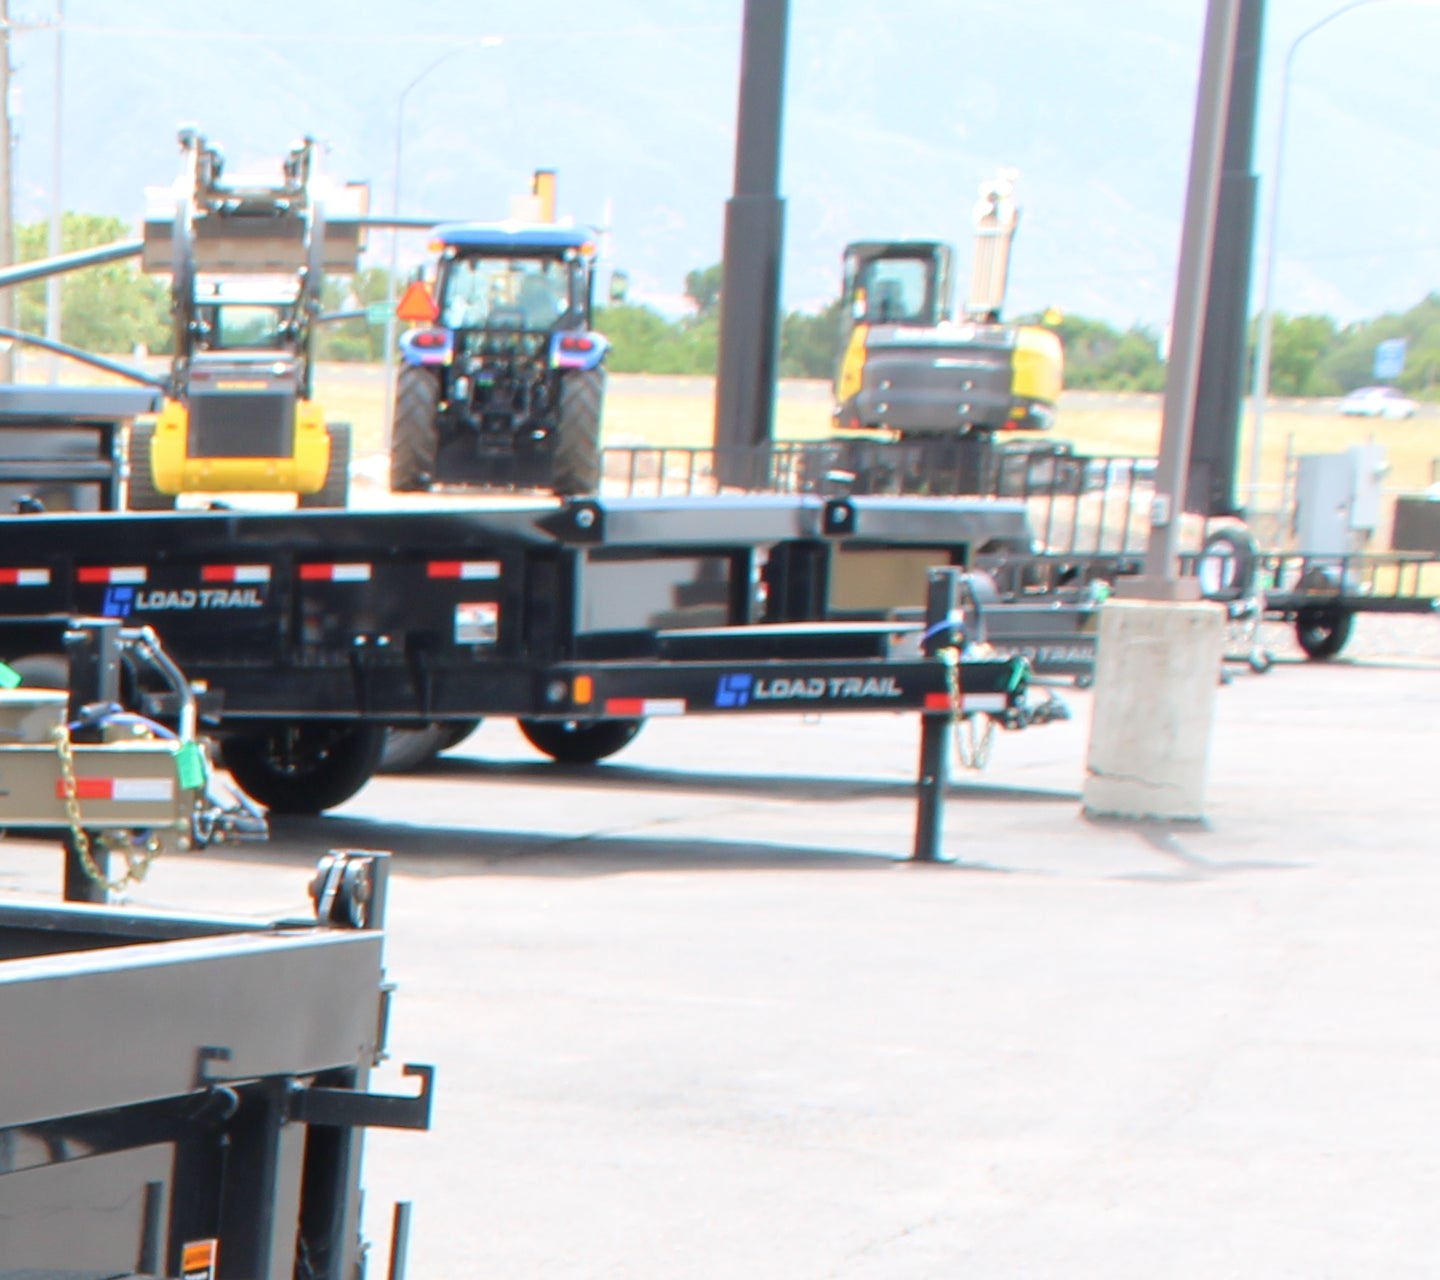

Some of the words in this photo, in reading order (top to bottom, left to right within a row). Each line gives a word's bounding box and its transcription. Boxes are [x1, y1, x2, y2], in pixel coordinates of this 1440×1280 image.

[135, 589, 197, 611] LOAD
[198, 588, 264, 609] TRAIL
[753, 678, 826, 700] LOAD
[827, 676, 903, 698] TRAIL
